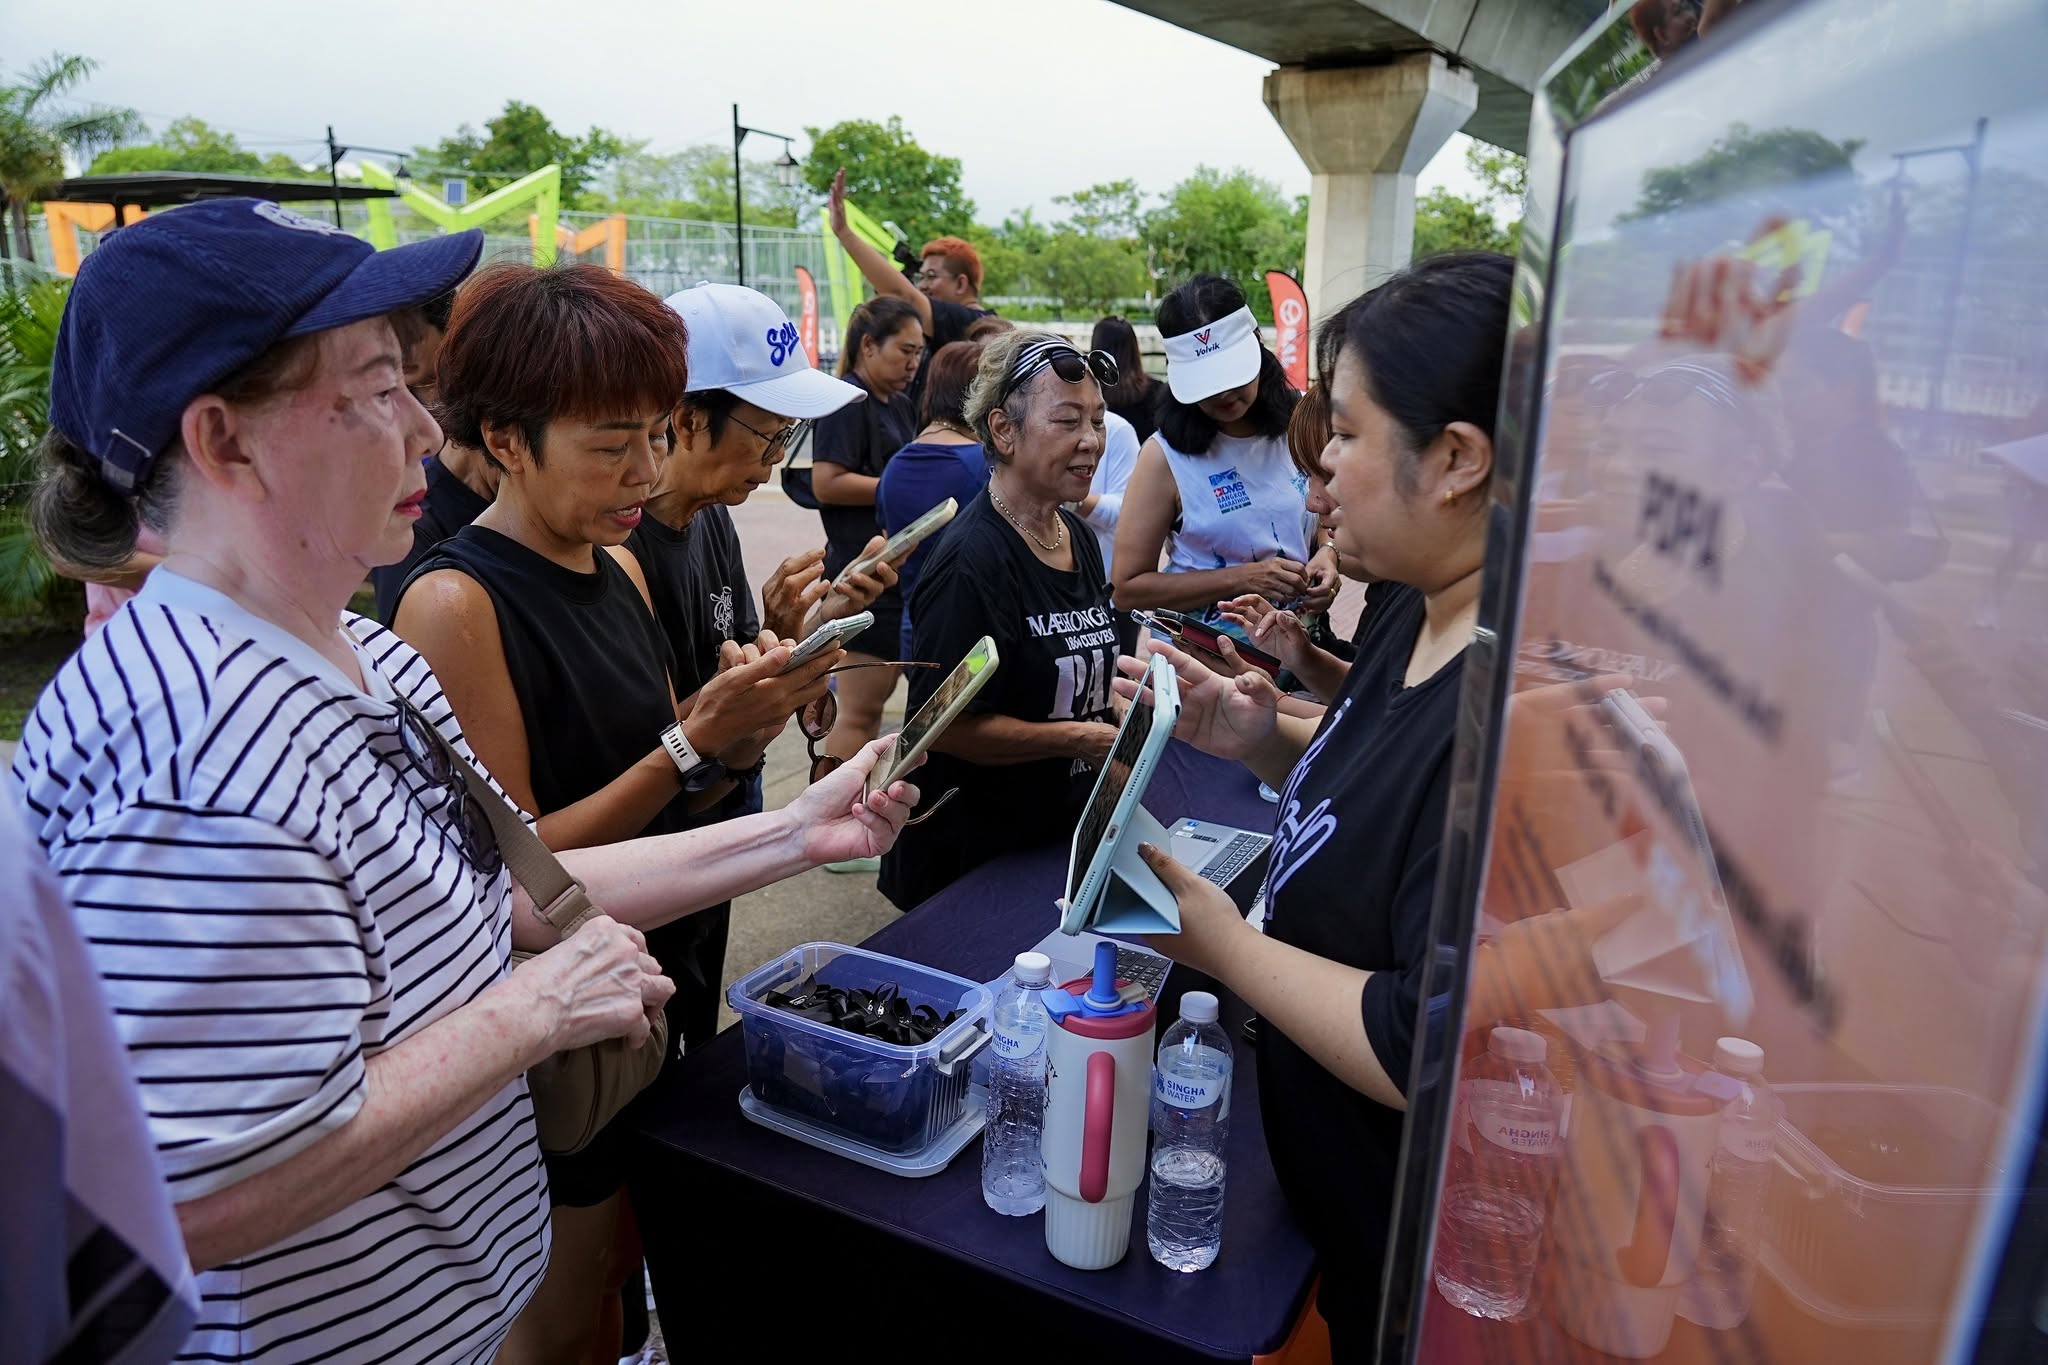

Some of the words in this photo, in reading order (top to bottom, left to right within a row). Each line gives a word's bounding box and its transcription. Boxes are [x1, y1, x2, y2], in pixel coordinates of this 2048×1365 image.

[1194, 342, 1220, 357] Volvik
[1216, 489, 1247, 504] BANGKOK
[1219, 495, 1250, 509] MARATHON
[1080, 628, 1116, 647] CURVES
[1167, 1080, 1206, 1096] SINGHA
[1167, 1087, 1196, 1104] WATER
